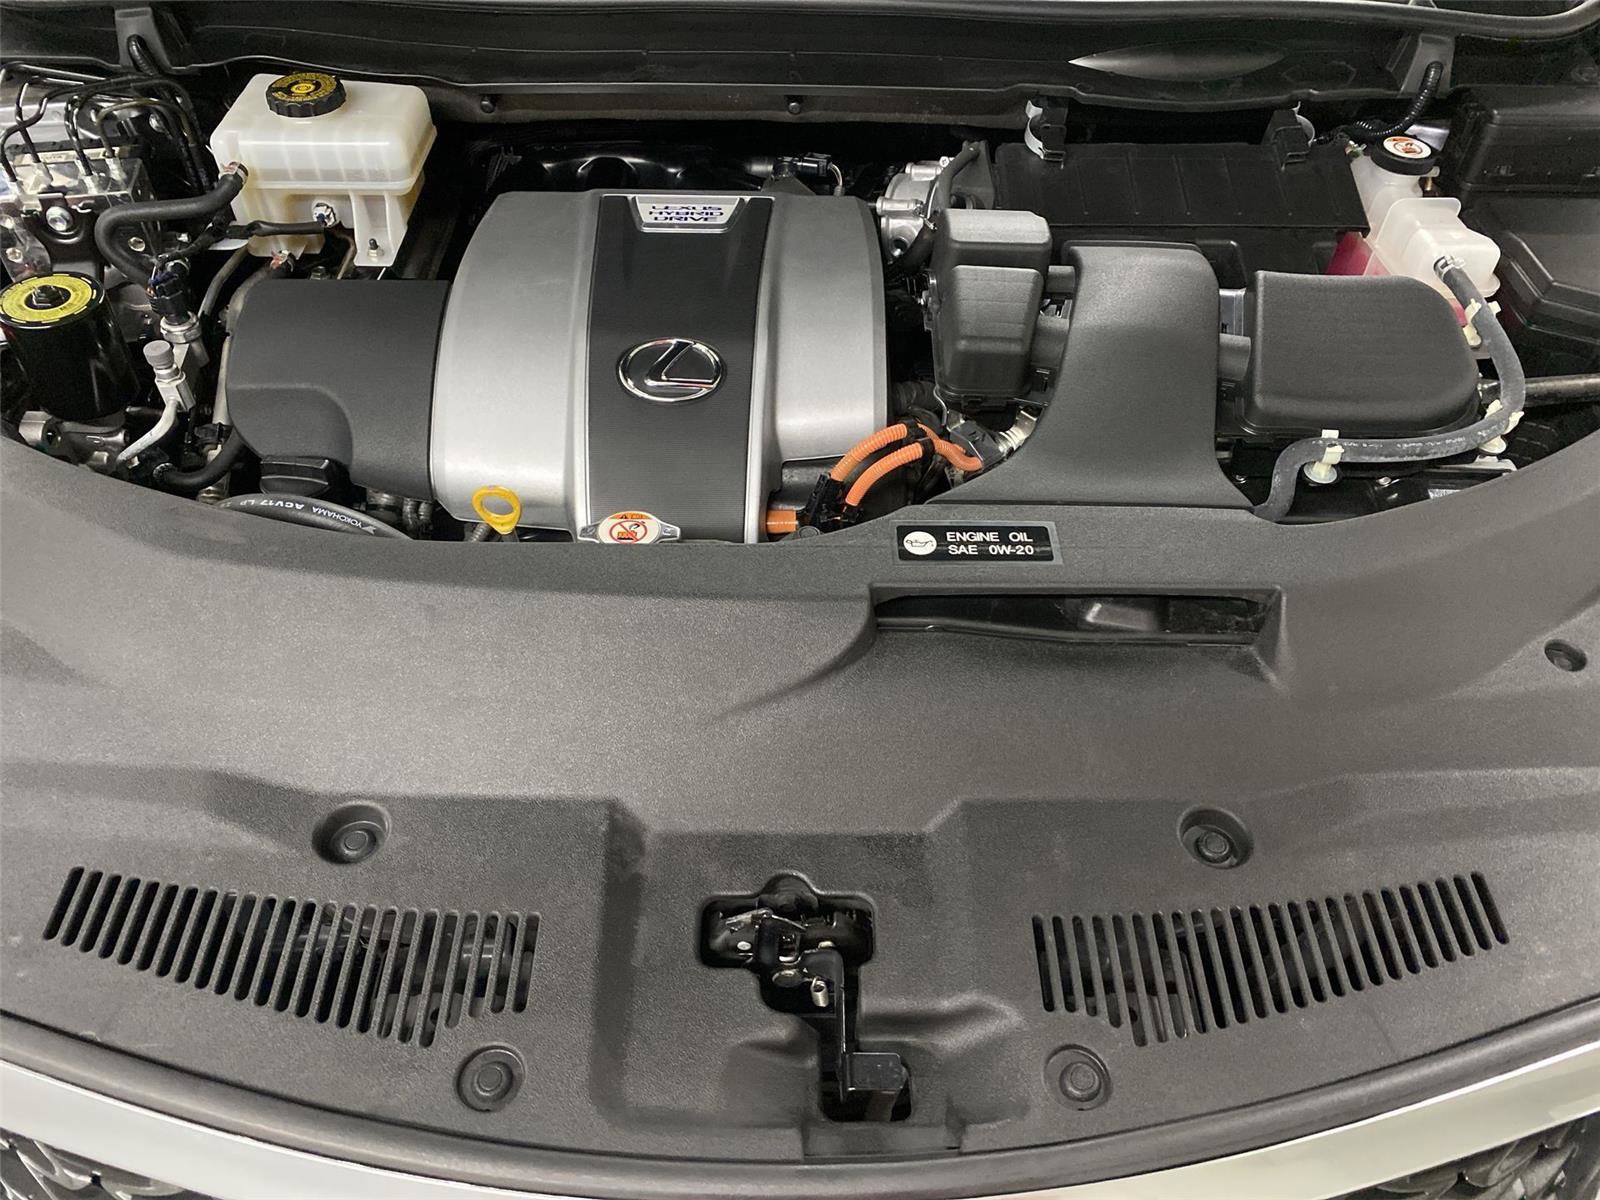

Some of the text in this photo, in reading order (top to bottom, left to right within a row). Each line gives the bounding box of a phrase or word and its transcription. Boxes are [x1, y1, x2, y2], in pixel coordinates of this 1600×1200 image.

[260, 499, 305, 510] ACV17
[312, 506, 363, 529] YOKOHAMA
[946, 531, 1034, 542] ENGINE OIL
[947, 544, 1034, 555] SAE 0W-20
